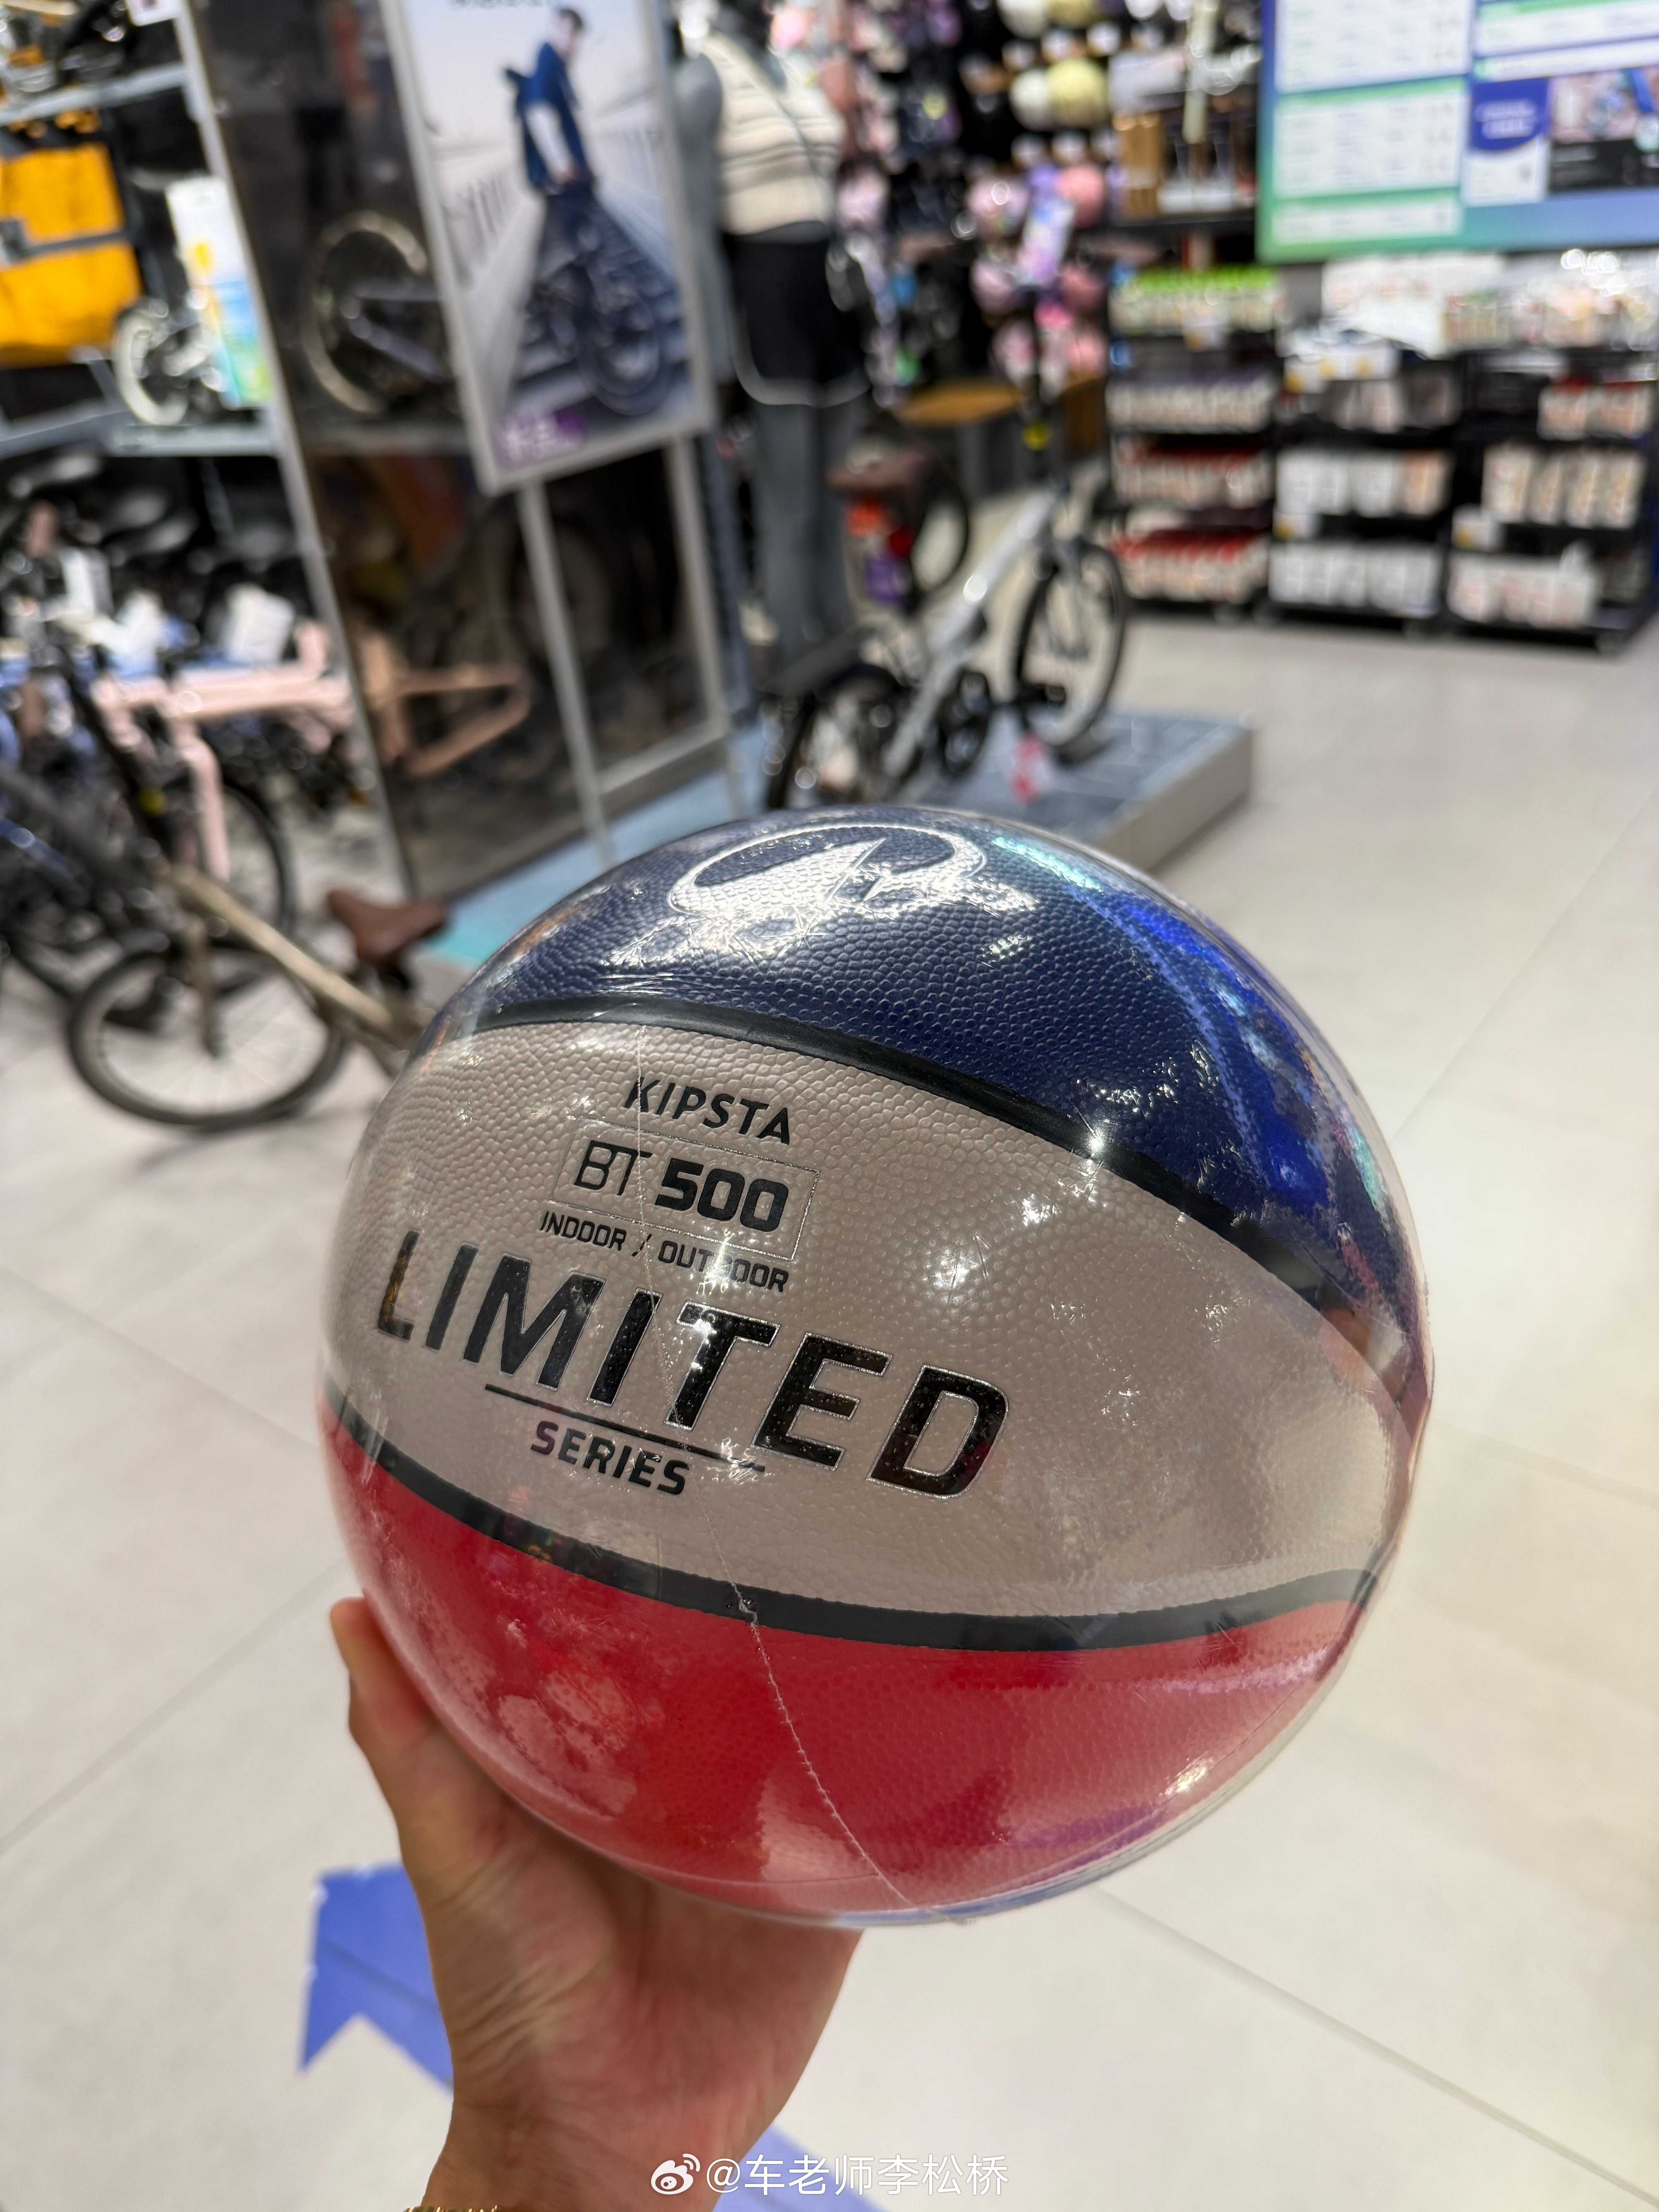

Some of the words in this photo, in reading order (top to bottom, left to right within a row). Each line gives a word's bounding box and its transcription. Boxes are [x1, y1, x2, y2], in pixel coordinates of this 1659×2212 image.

[624, 1075, 792, 1146] KIPSTA
[572, 1139, 653, 1197] BT
[654, 1158, 789, 1233] 500
[538, 1211, 627, 1251] INDOOR
[632, 1234, 653, 1257] /
[375, 1230, 1009, 1499] LIMITED
[530, 1420, 690, 1496] SERIES
